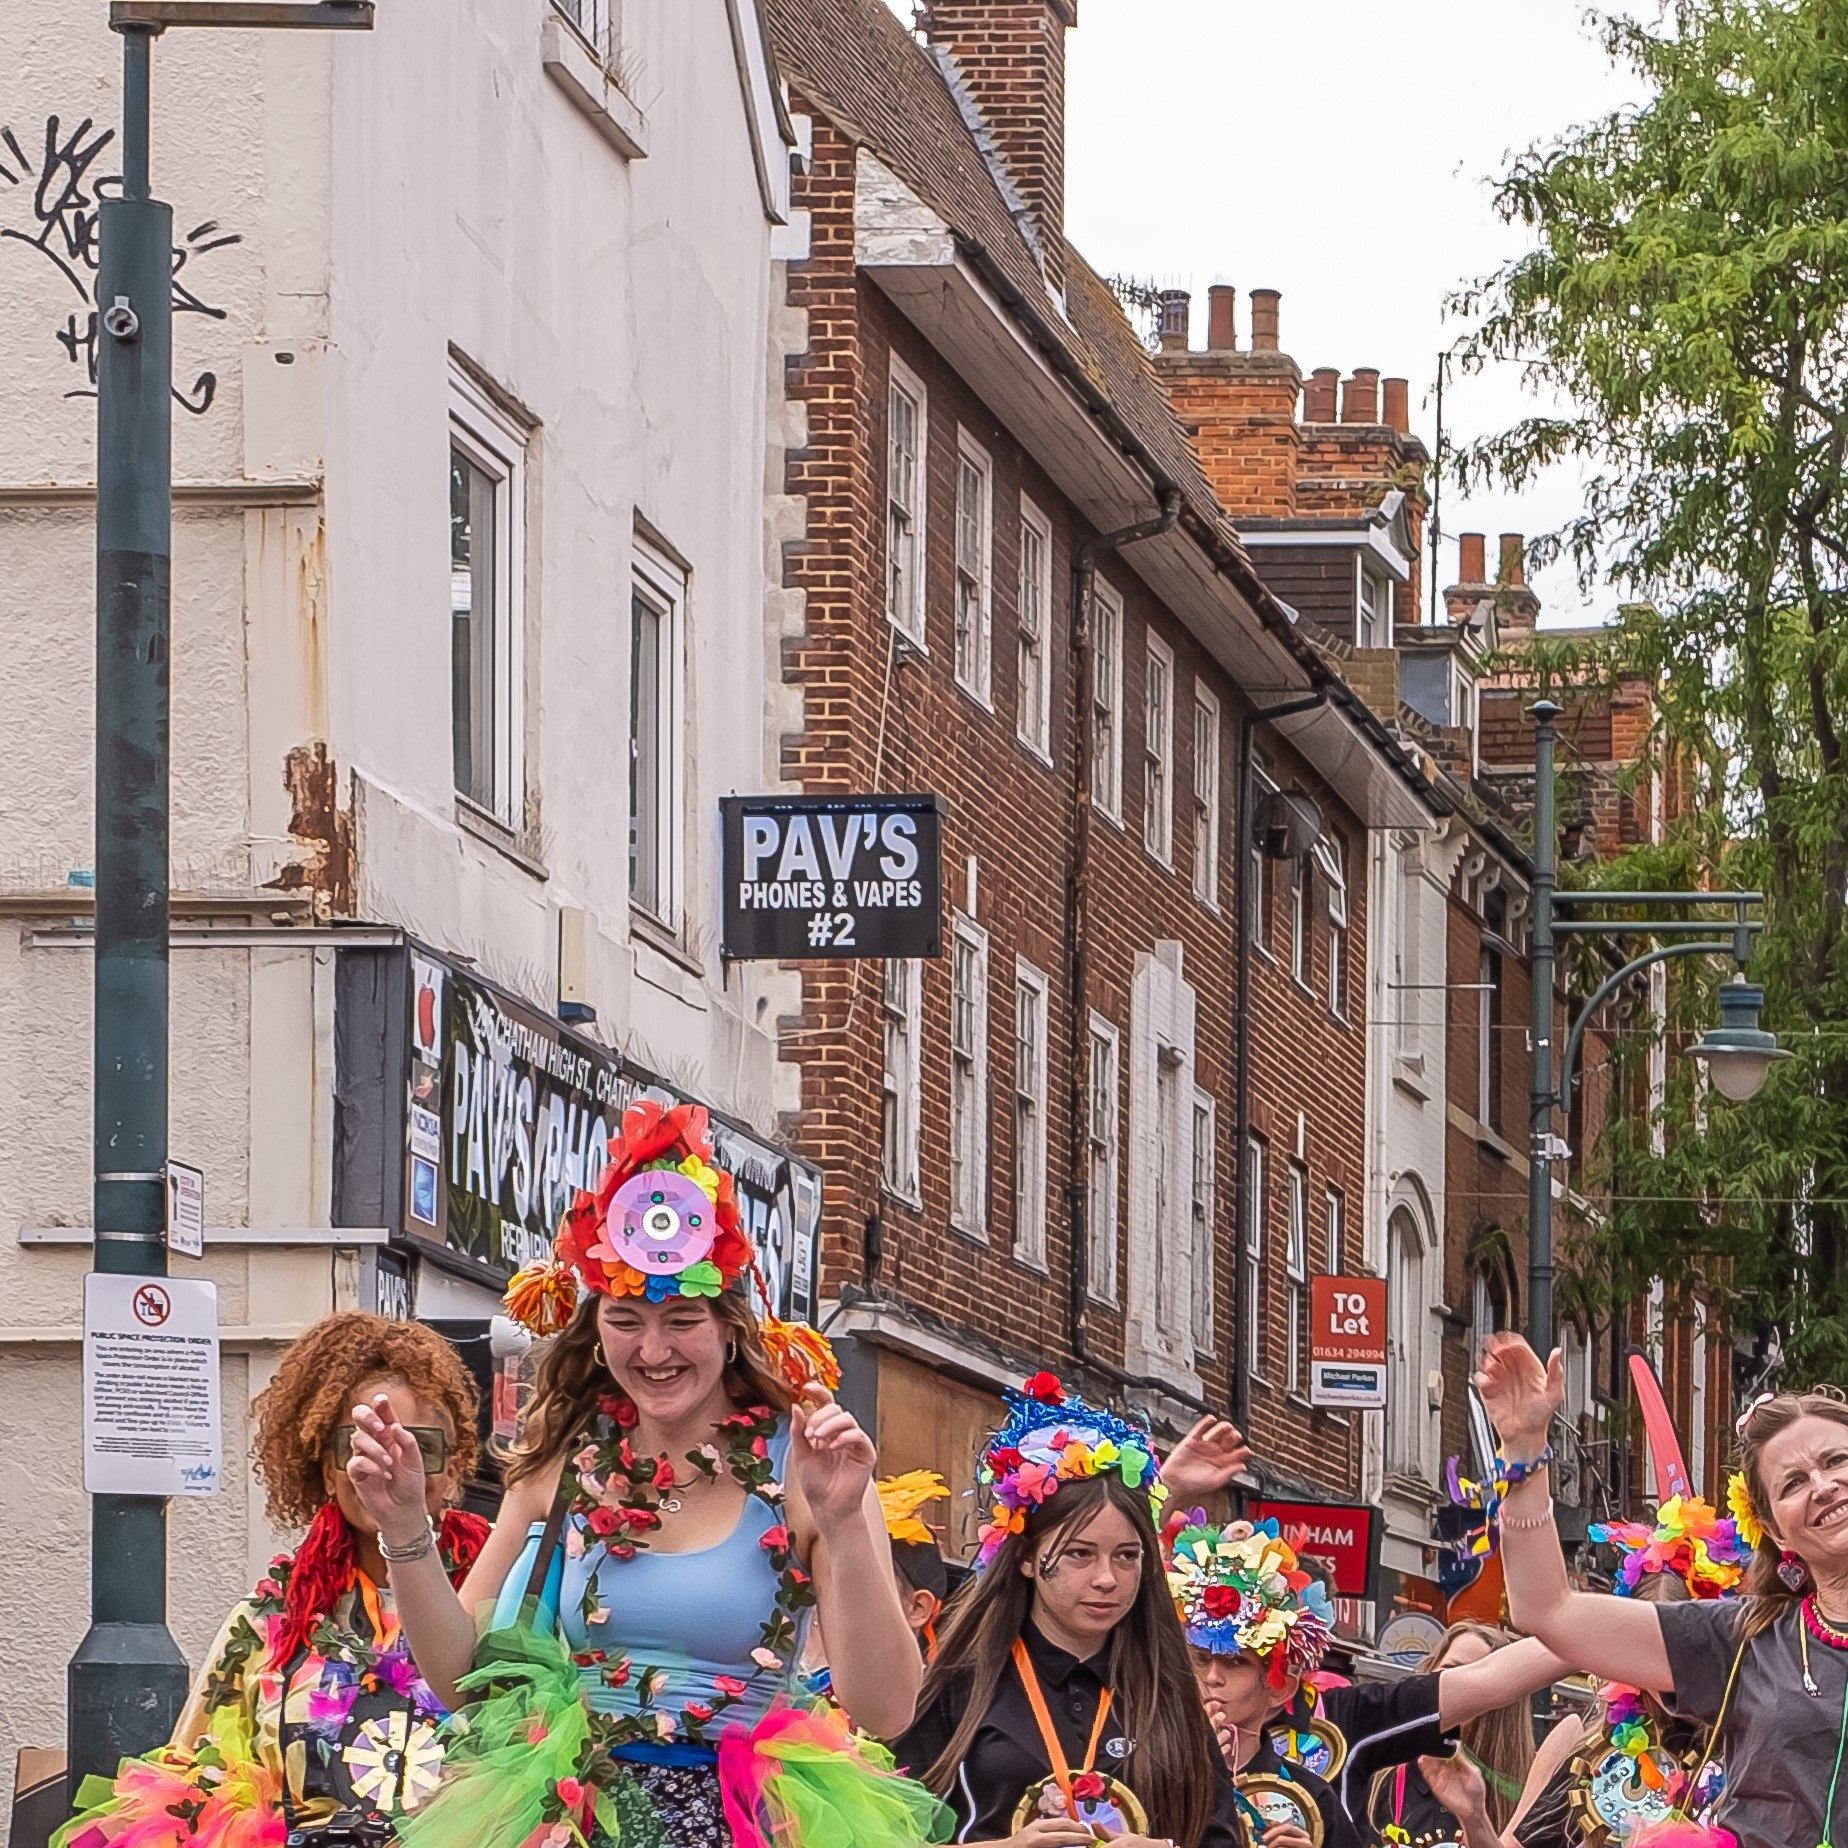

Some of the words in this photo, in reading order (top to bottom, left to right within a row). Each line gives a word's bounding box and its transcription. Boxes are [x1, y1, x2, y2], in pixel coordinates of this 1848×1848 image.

[742, 813, 919, 881] PAV'S
[739, 881, 826, 909] PHONES
[832, 881, 848, 908] &
[854, 880, 922, 908] VAPES
[807, 912, 856, 947] #2
[451, 1039, 534, 1223] PAV'S
[1332, 1292, 1366, 1315] TO
[1330, 1312, 1370, 1337] Let
[1282, 1523, 1354, 1547] INHAM
